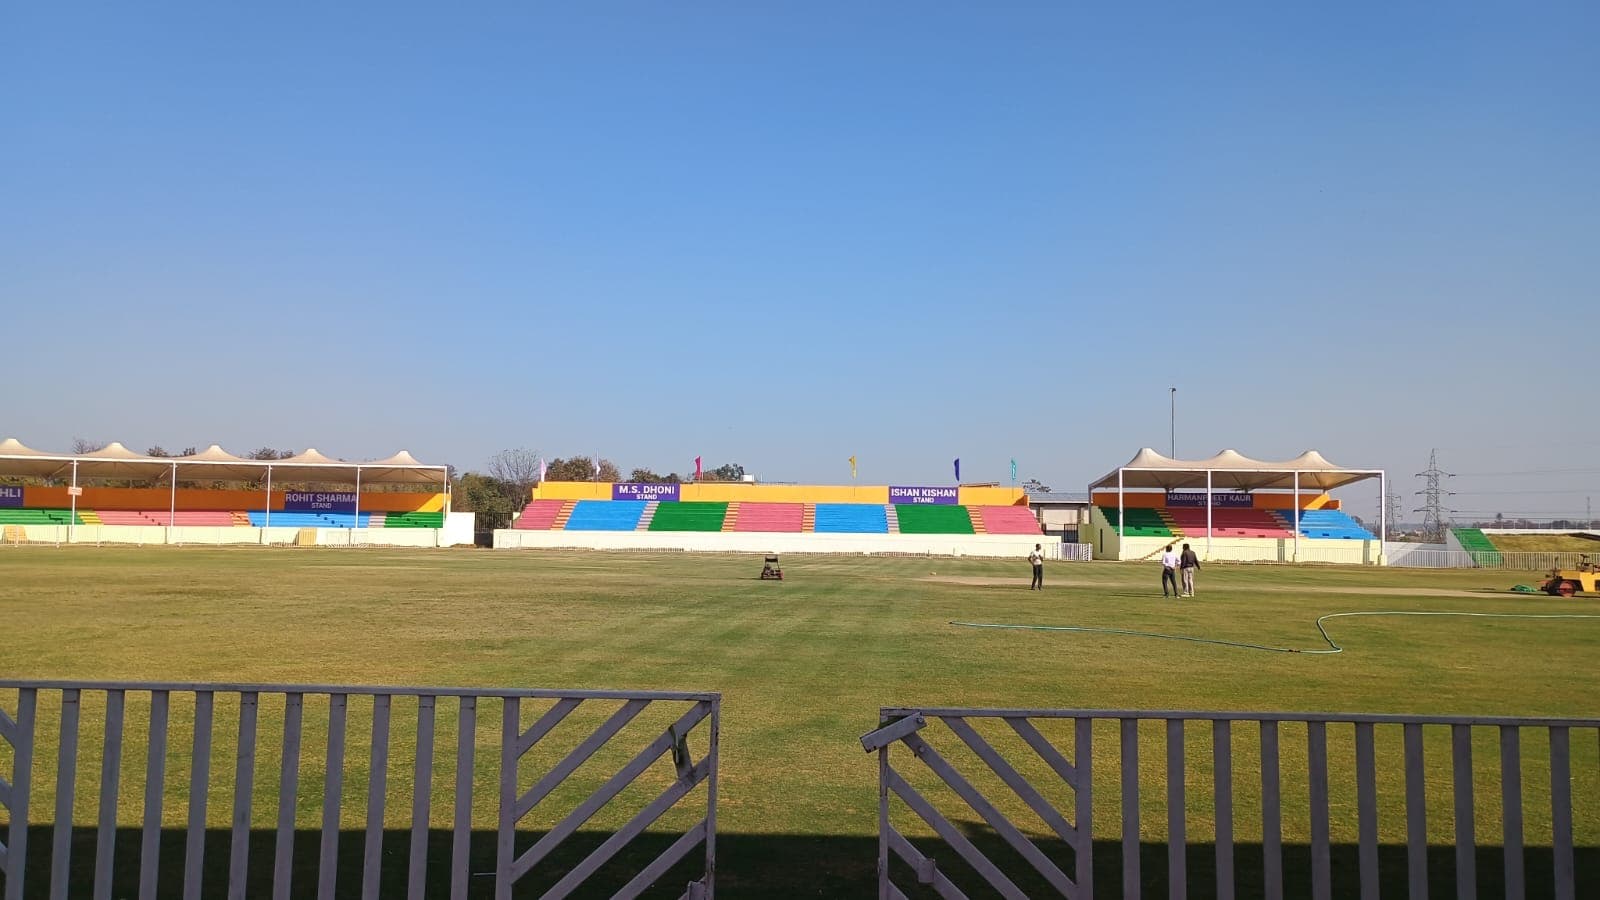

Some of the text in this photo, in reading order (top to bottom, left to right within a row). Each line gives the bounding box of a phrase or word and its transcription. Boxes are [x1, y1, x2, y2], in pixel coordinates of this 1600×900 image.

[619, 485, 675, 494] M.S. DHONI
[891, 488, 956, 497] ISHAN KISHAN
[286, 493, 358, 503] ROHIT SHARMA
[1167, 494, 1251, 502] HARMANPEET KAUR
